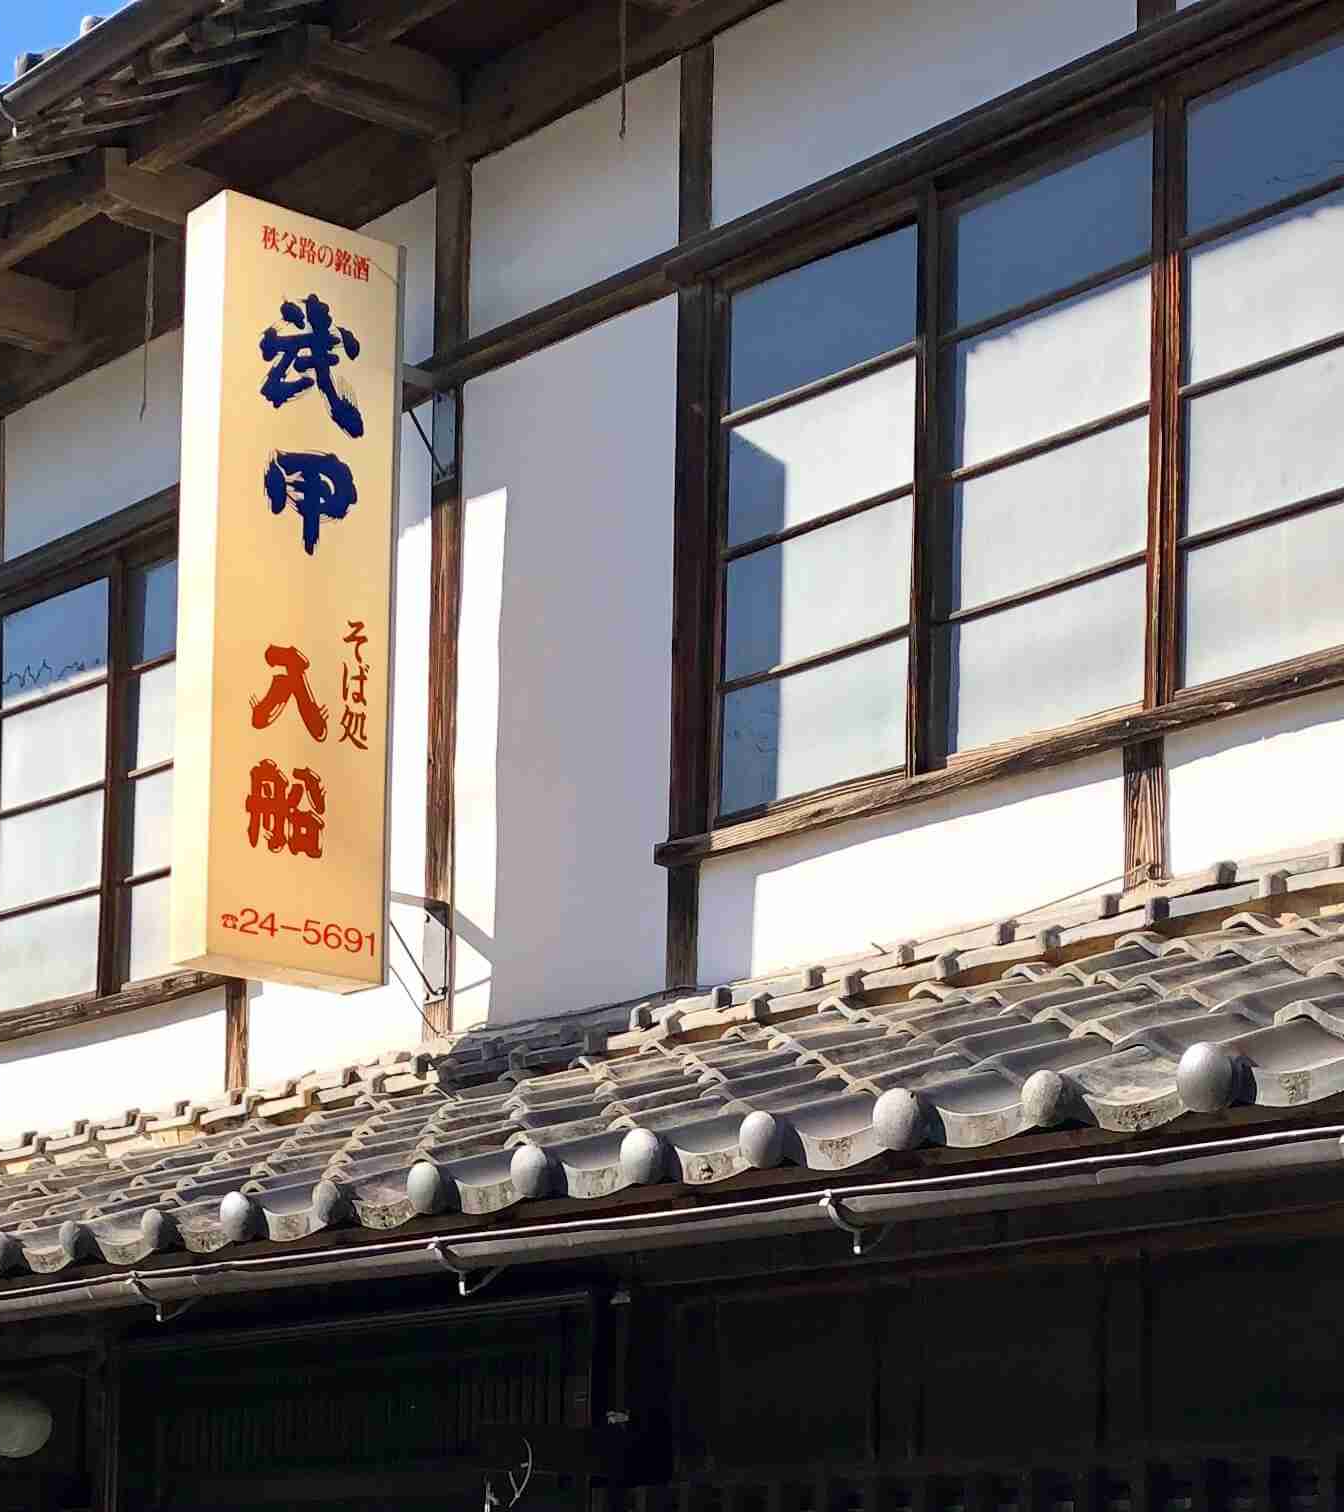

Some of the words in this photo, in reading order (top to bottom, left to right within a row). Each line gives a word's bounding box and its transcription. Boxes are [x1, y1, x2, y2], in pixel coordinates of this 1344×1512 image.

[260, 225, 370, 282] 秩父路の銘酒
[259, 293, 364, 555] 武甲
[245, 643, 329, 859] 入船
[338, 619, 370, 751] そば処
